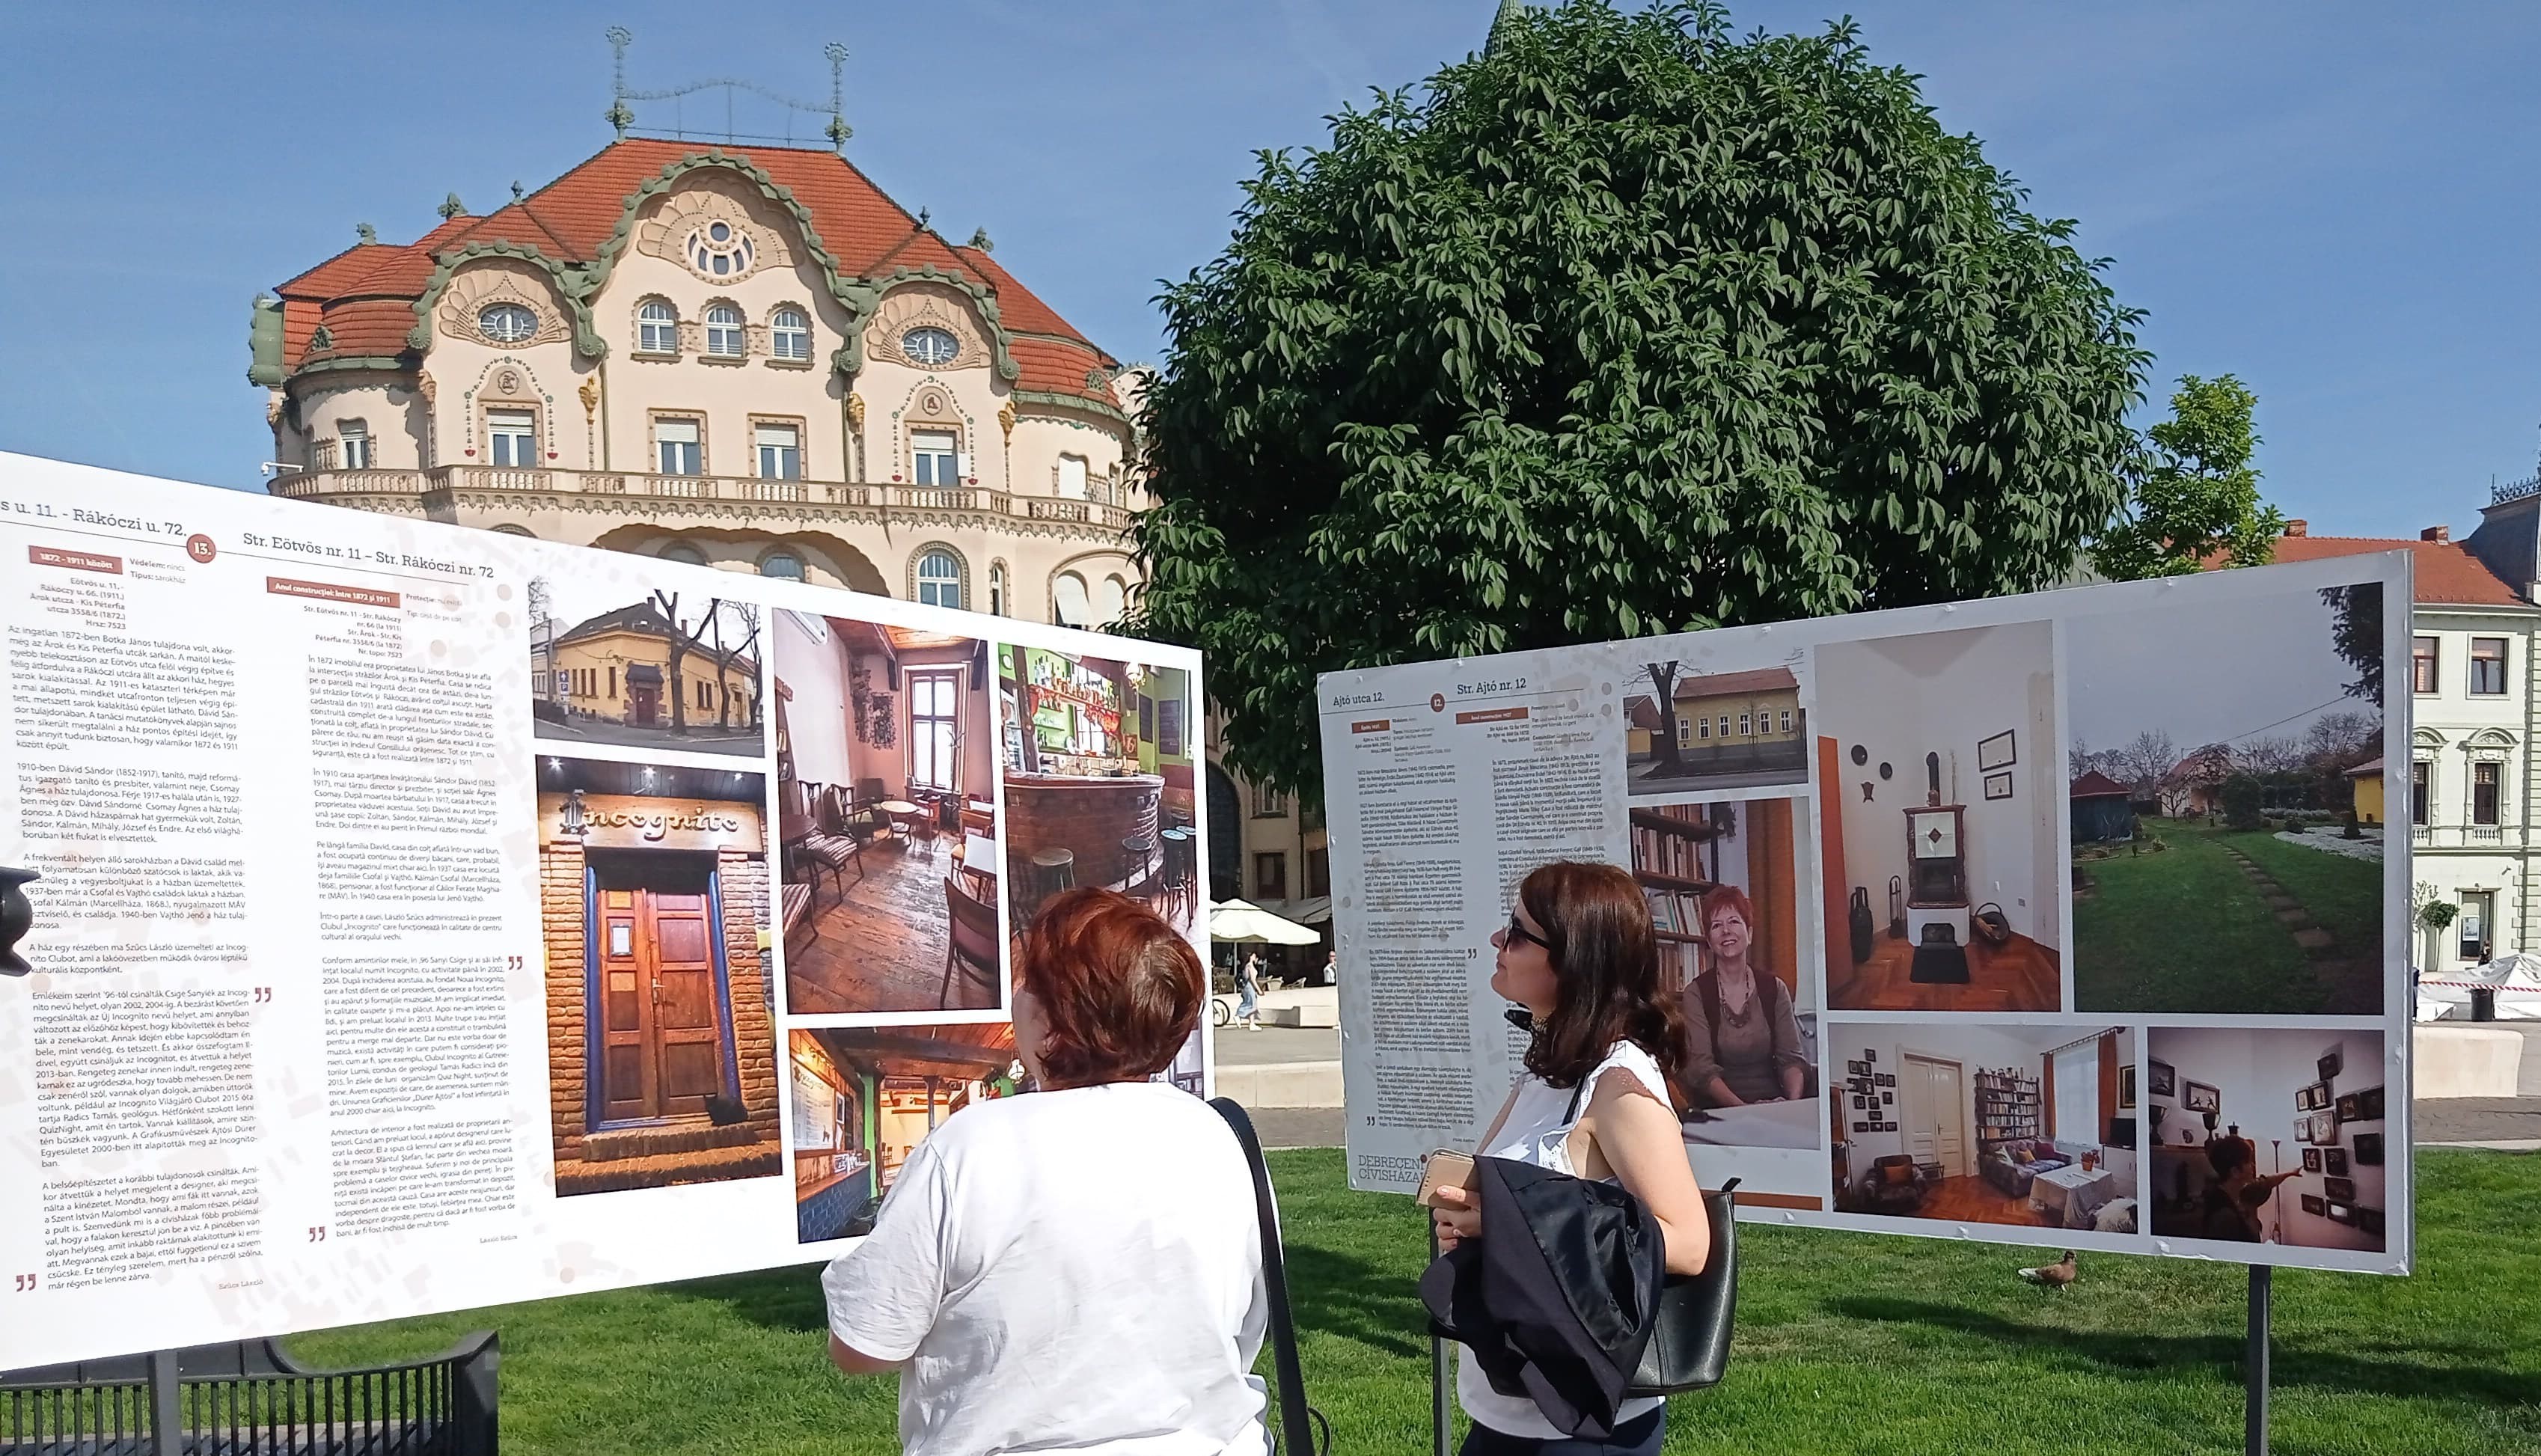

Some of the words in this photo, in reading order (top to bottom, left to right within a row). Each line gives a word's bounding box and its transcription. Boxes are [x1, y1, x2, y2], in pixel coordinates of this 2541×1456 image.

[13, 502, 31, 514] u.
[35, 504, 57, 518] 11.
[72, 508, 141, 530] Rákóczi
[145, 521, 160, 533] u.
[164, 521, 186, 536] 72.
[194, 542, 212, 556] 13.
[243, 532, 267, 547] Str.
[271, 536, 322, 554] Eötvös
[325, 546, 343, 557] nr.
[347, 547, 361, 560] 11
[376, 551, 398, 565] Str.
[401, 554, 455, 572] Rákóczi
[459, 565, 475, 575] nr.
[478, 566, 494, 578] 72
[39, 552, 61, 562] 1872
[65, 556, 85, 565] 1911
[85, 558, 113, 569] között
[1457, 684, 1473, 694] Str.
[1476, 679, 1496, 694] Ajtó
[1499, 682, 1512, 691] nr.
[1515, 677, 1526, 688] 12
[1333, 694, 1351, 707] Ajtó
[1351, 694, 1371, 704] utca
[1372, 691, 1384, 702] 12.
[1358, 1166, 1424, 1184] CÍVISHÁZA
